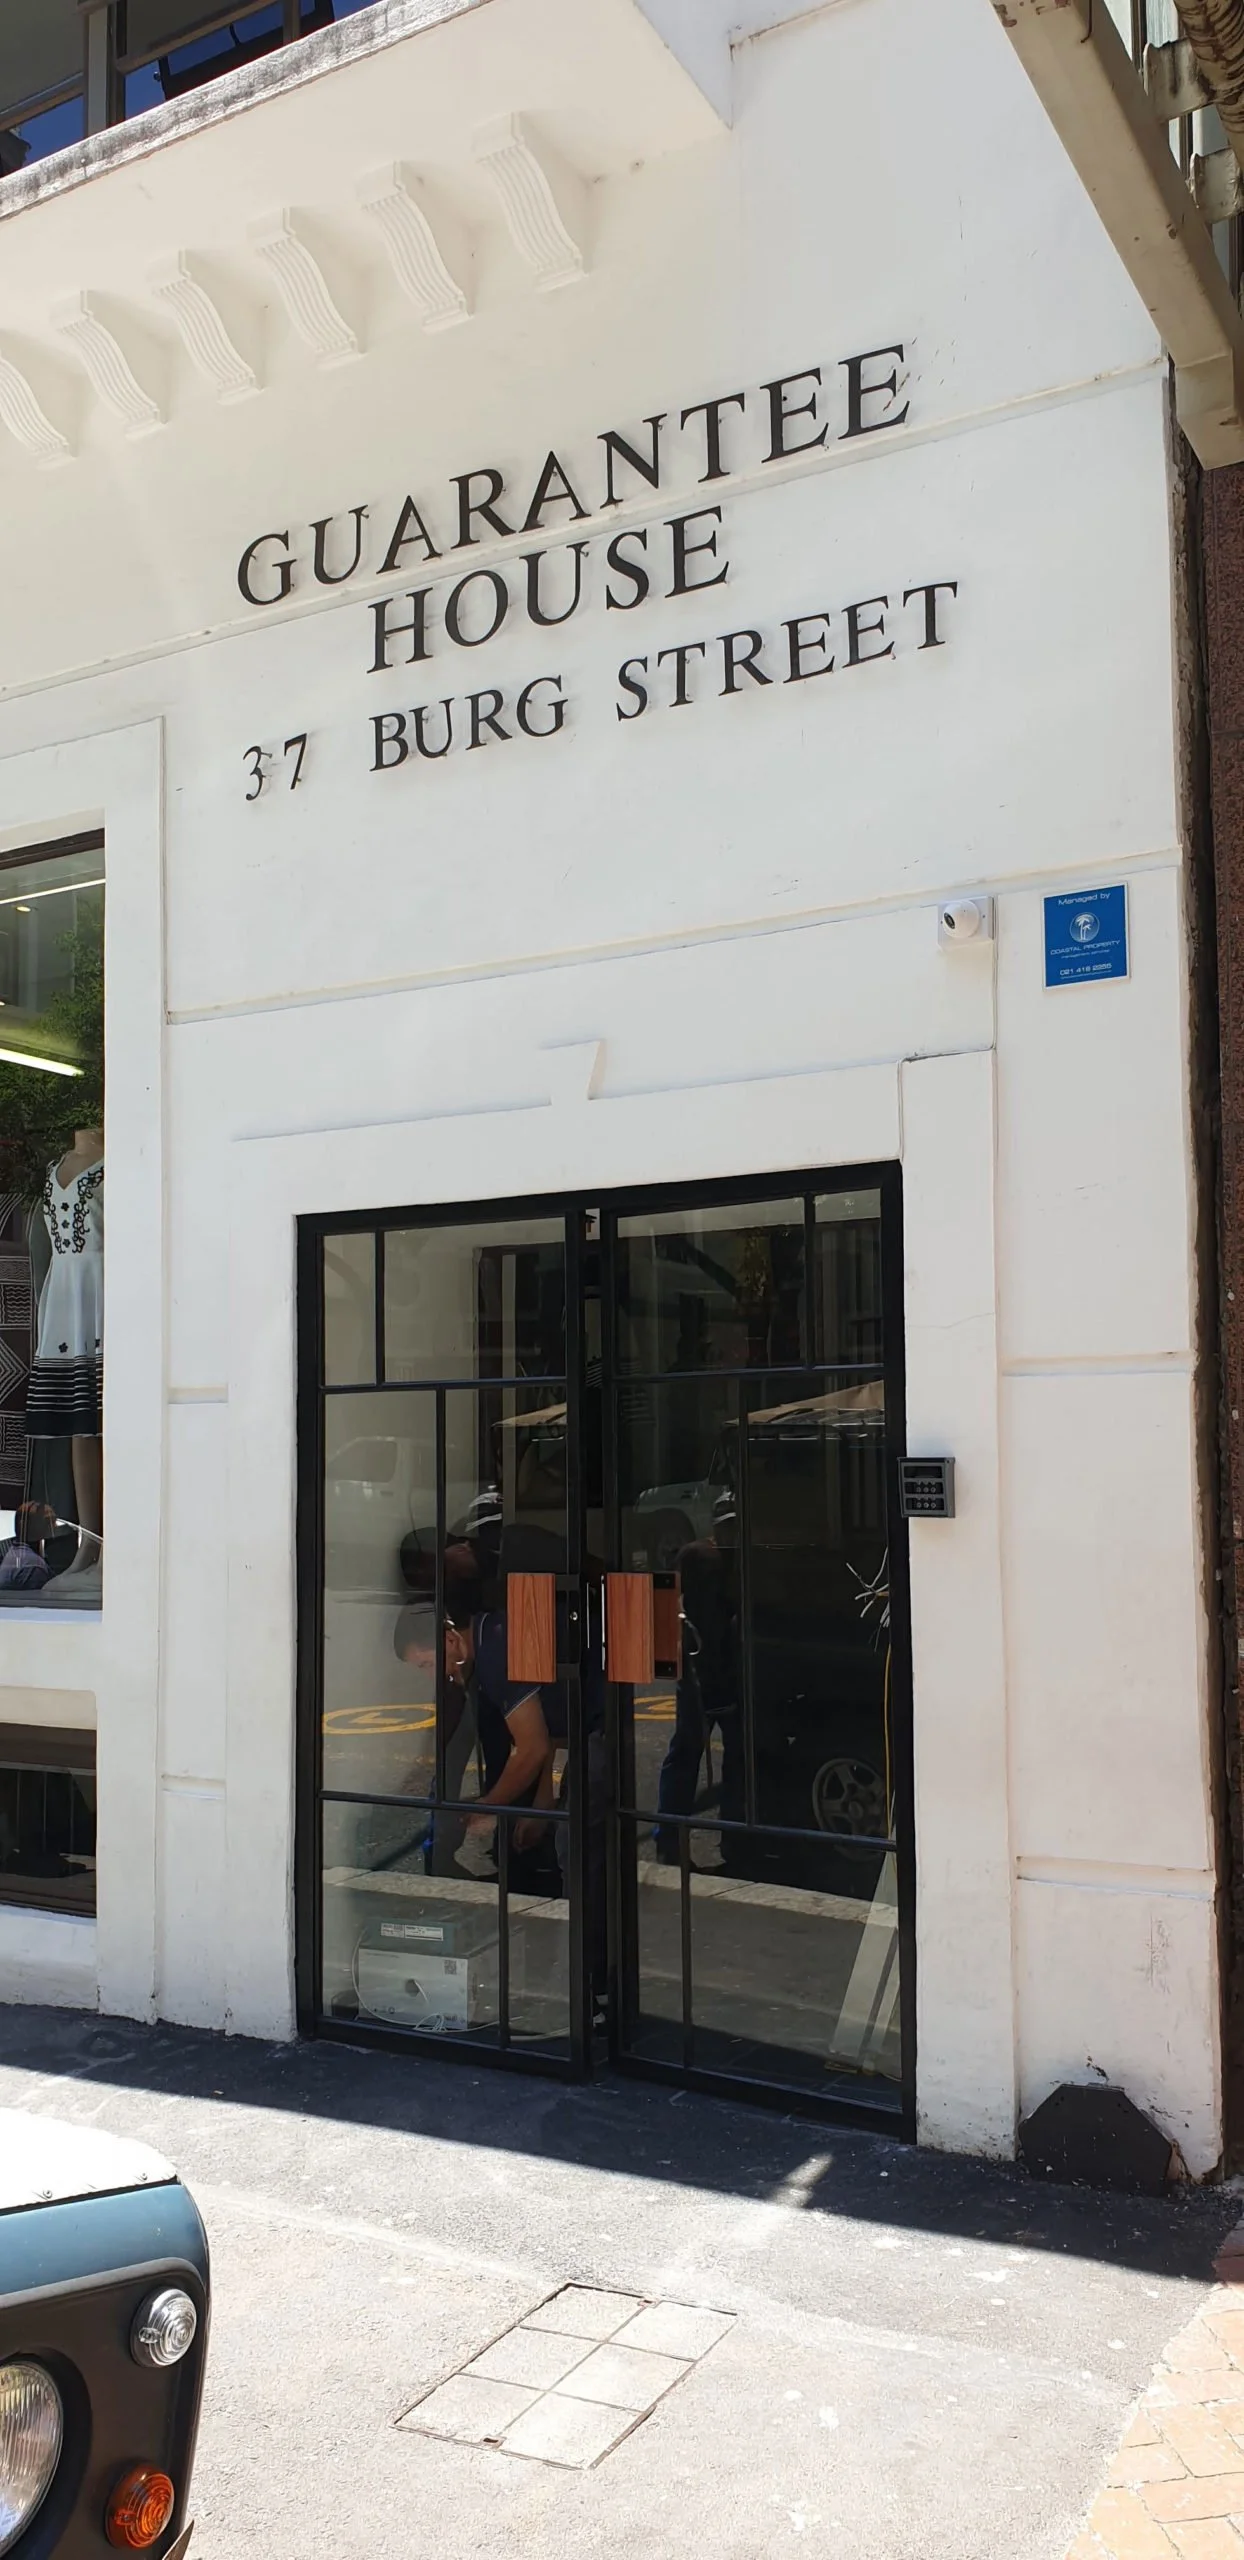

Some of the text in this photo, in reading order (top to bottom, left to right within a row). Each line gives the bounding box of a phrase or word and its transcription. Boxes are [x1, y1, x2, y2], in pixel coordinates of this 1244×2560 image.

[237, 343, 911, 606] GUARANTEE
[366, 505, 730, 674] HOUSE
[242, 581, 958, 801] 37 BURG STREET
[1050, 946, 1082, 956] COASTAL
[1058, 892, 1111, 905] Managed by
